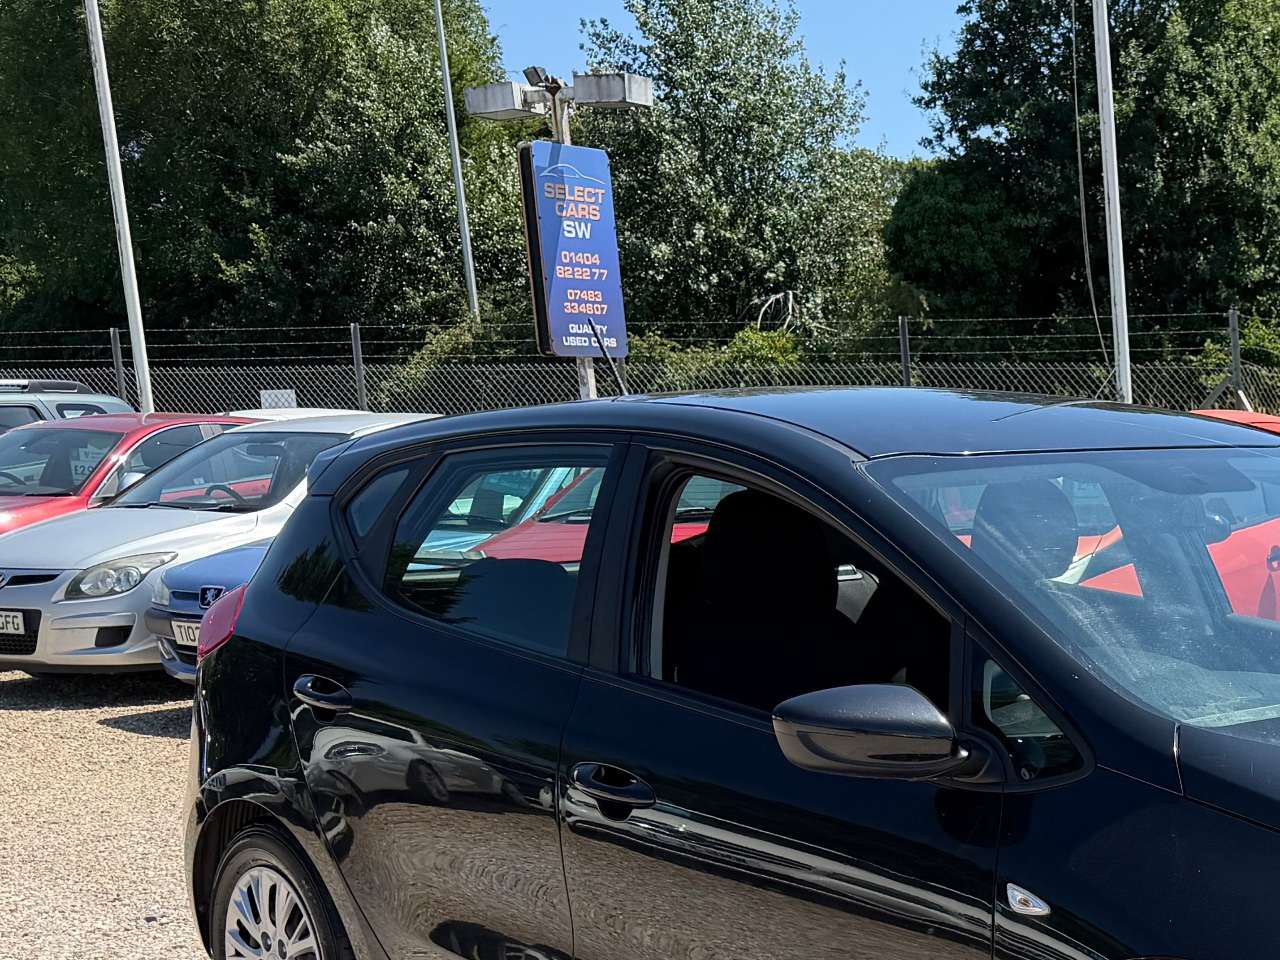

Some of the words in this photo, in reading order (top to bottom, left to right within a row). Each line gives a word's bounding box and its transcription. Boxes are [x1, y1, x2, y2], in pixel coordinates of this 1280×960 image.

[544, 182, 606, 203] SELECT
[555, 202, 600, 221] CARS
[563, 220, 592, 239] SW
[561, 251, 600, 265] 01404
[567, 289, 602, 302] 07483
[562, 336, 589, 346] USED
[591, 337, 617, 347] CRS
